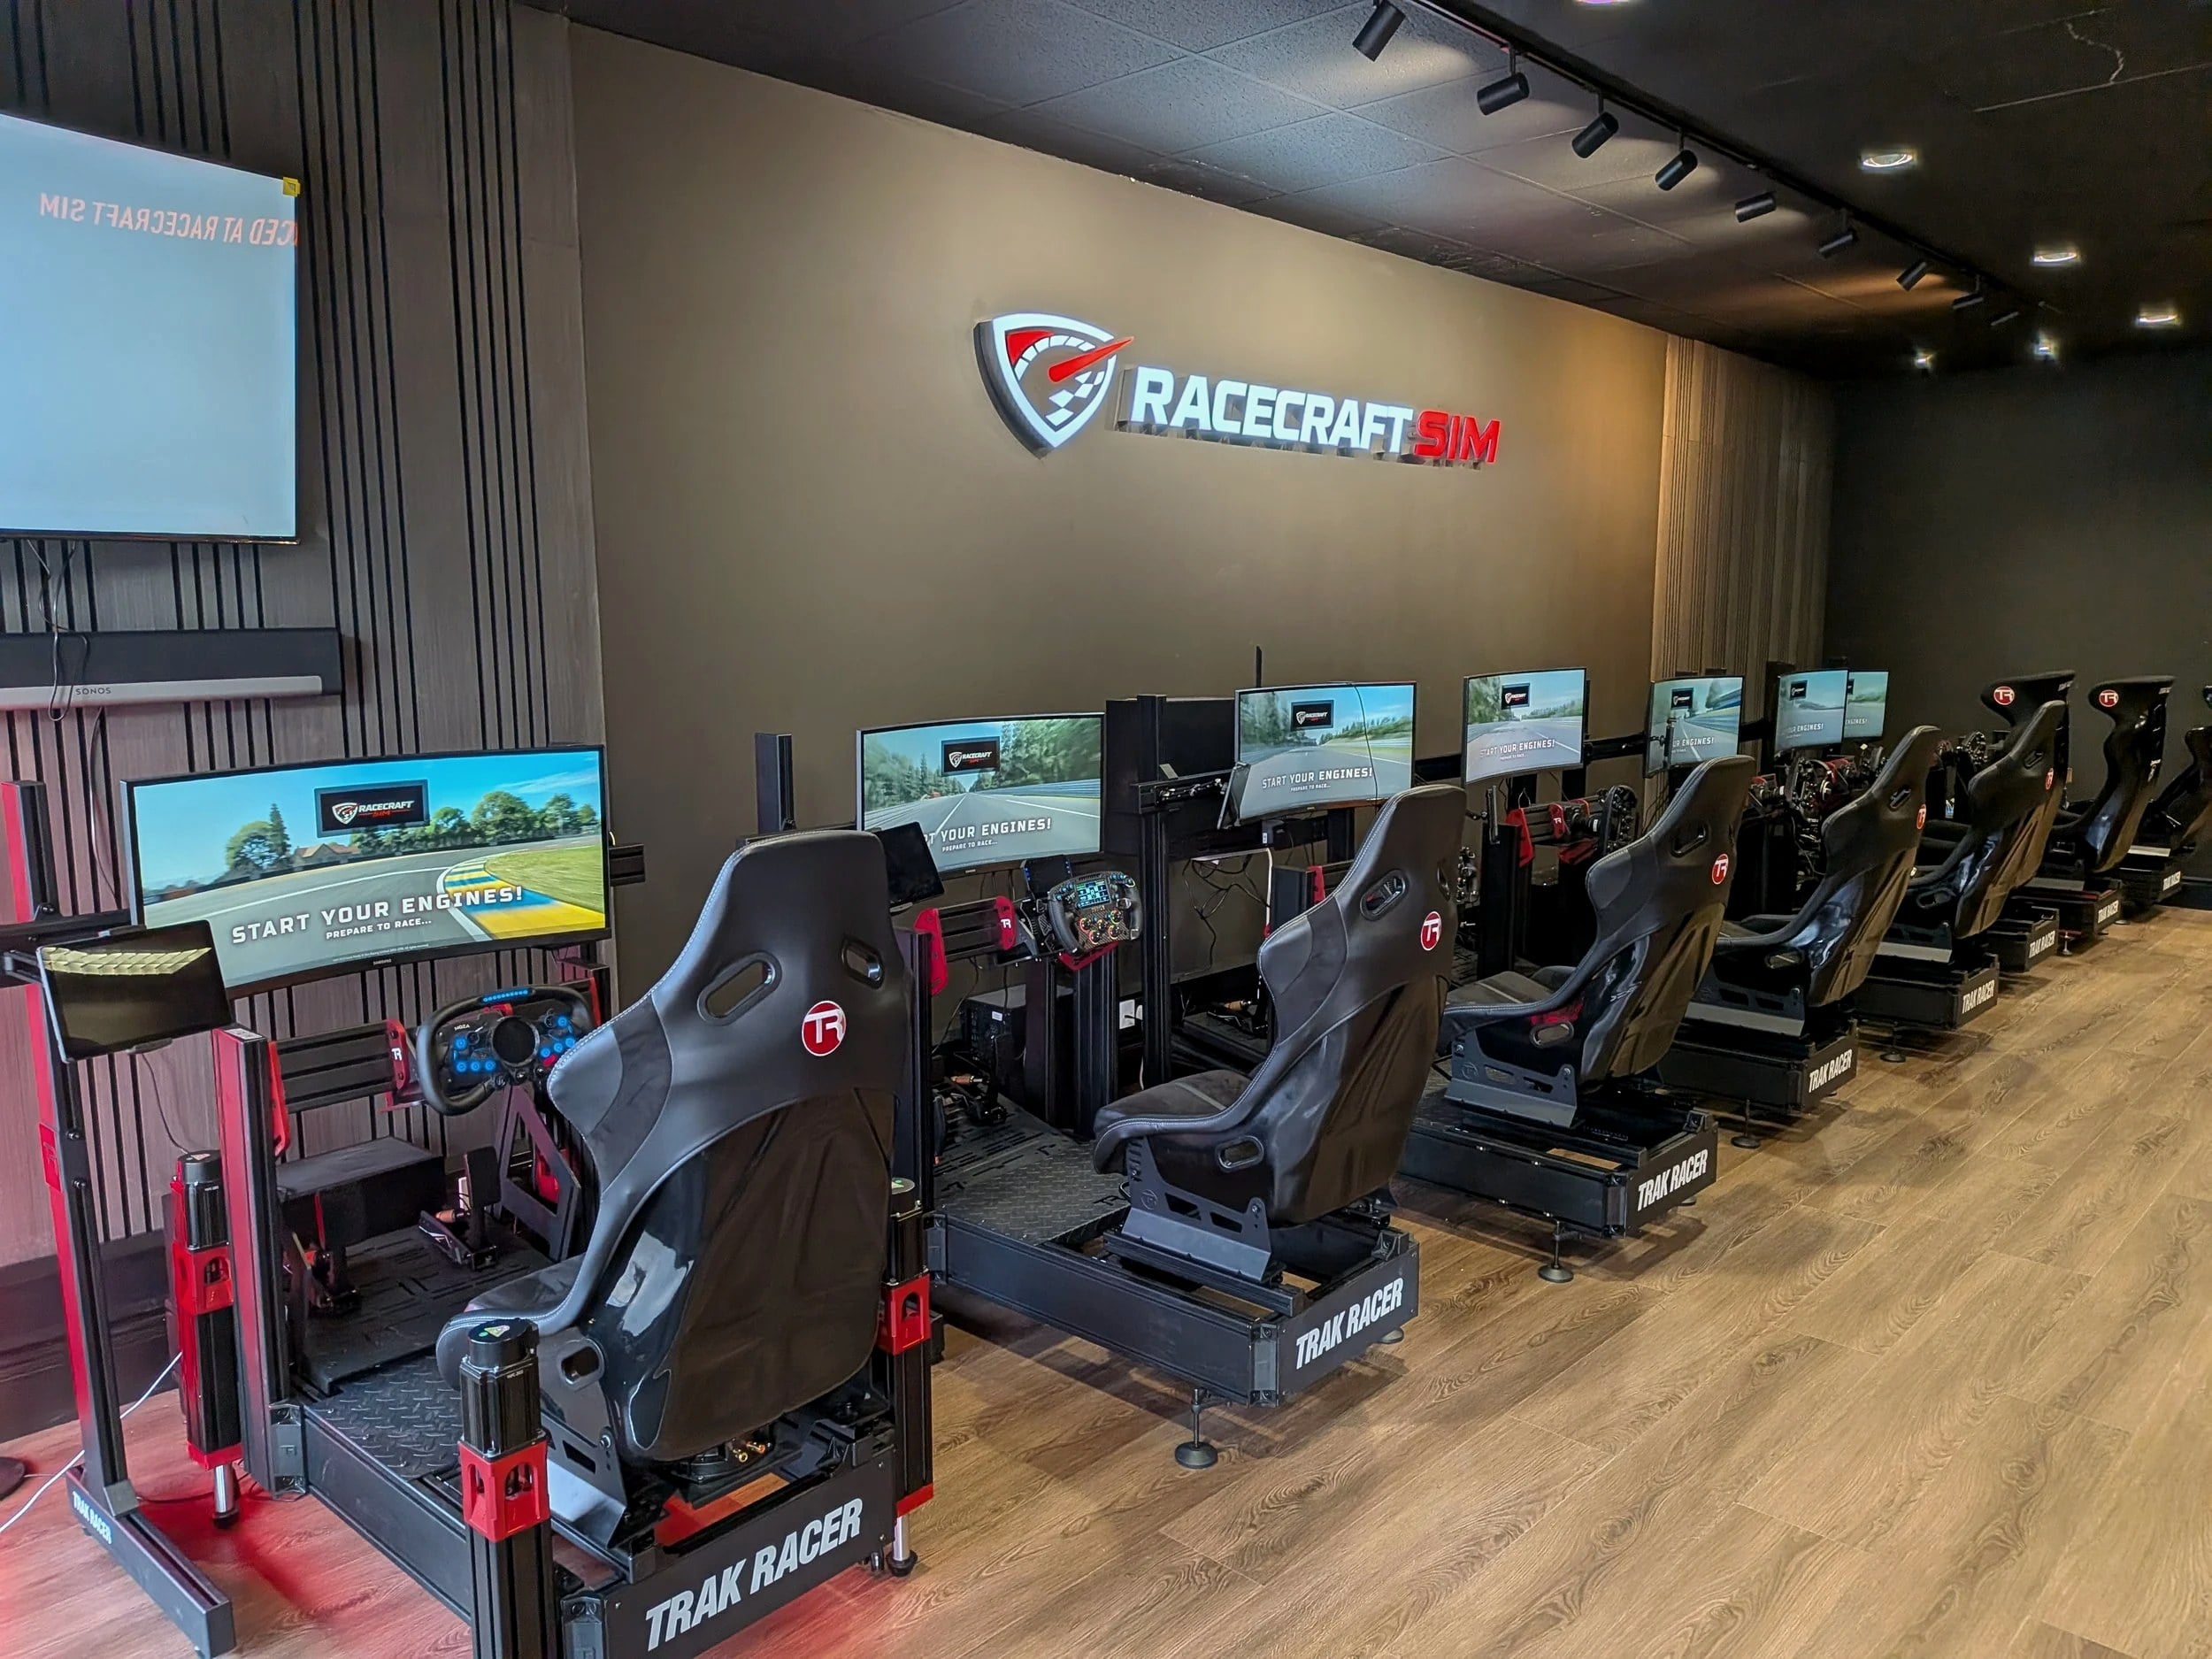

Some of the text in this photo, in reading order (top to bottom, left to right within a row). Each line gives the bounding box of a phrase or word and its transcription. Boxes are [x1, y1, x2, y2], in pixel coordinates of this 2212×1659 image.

[1130, 365, 1502, 464] RACECRAFT SIM
[75, 687, 111, 695] SONOS
[1499, 743, 1517, 754] YOUR
[1519, 739, 1555, 751] ENGINES!
[1262, 767, 1373, 789] START YOUR ENGINES!
[358, 800, 415, 813] RACECRAFT
[941, 826, 976, 842] YOUR
[981, 818, 1052, 836] ENGINES!
[232, 886, 523, 944] START YOUR ENGINES!
[326, 925, 373, 940] PREPARE
[376, 922, 391, 931] TO
[1962, 979, 1995, 1014] TRAK RACER
[1809, 1048, 1853, 1094] TRAK RACER
[1637, 1148, 1709, 1211] TRAK RACER
[1295, 1277, 1404, 1371] TRAK RACER
[645, 1497, 864, 1653] TRAK RACER
